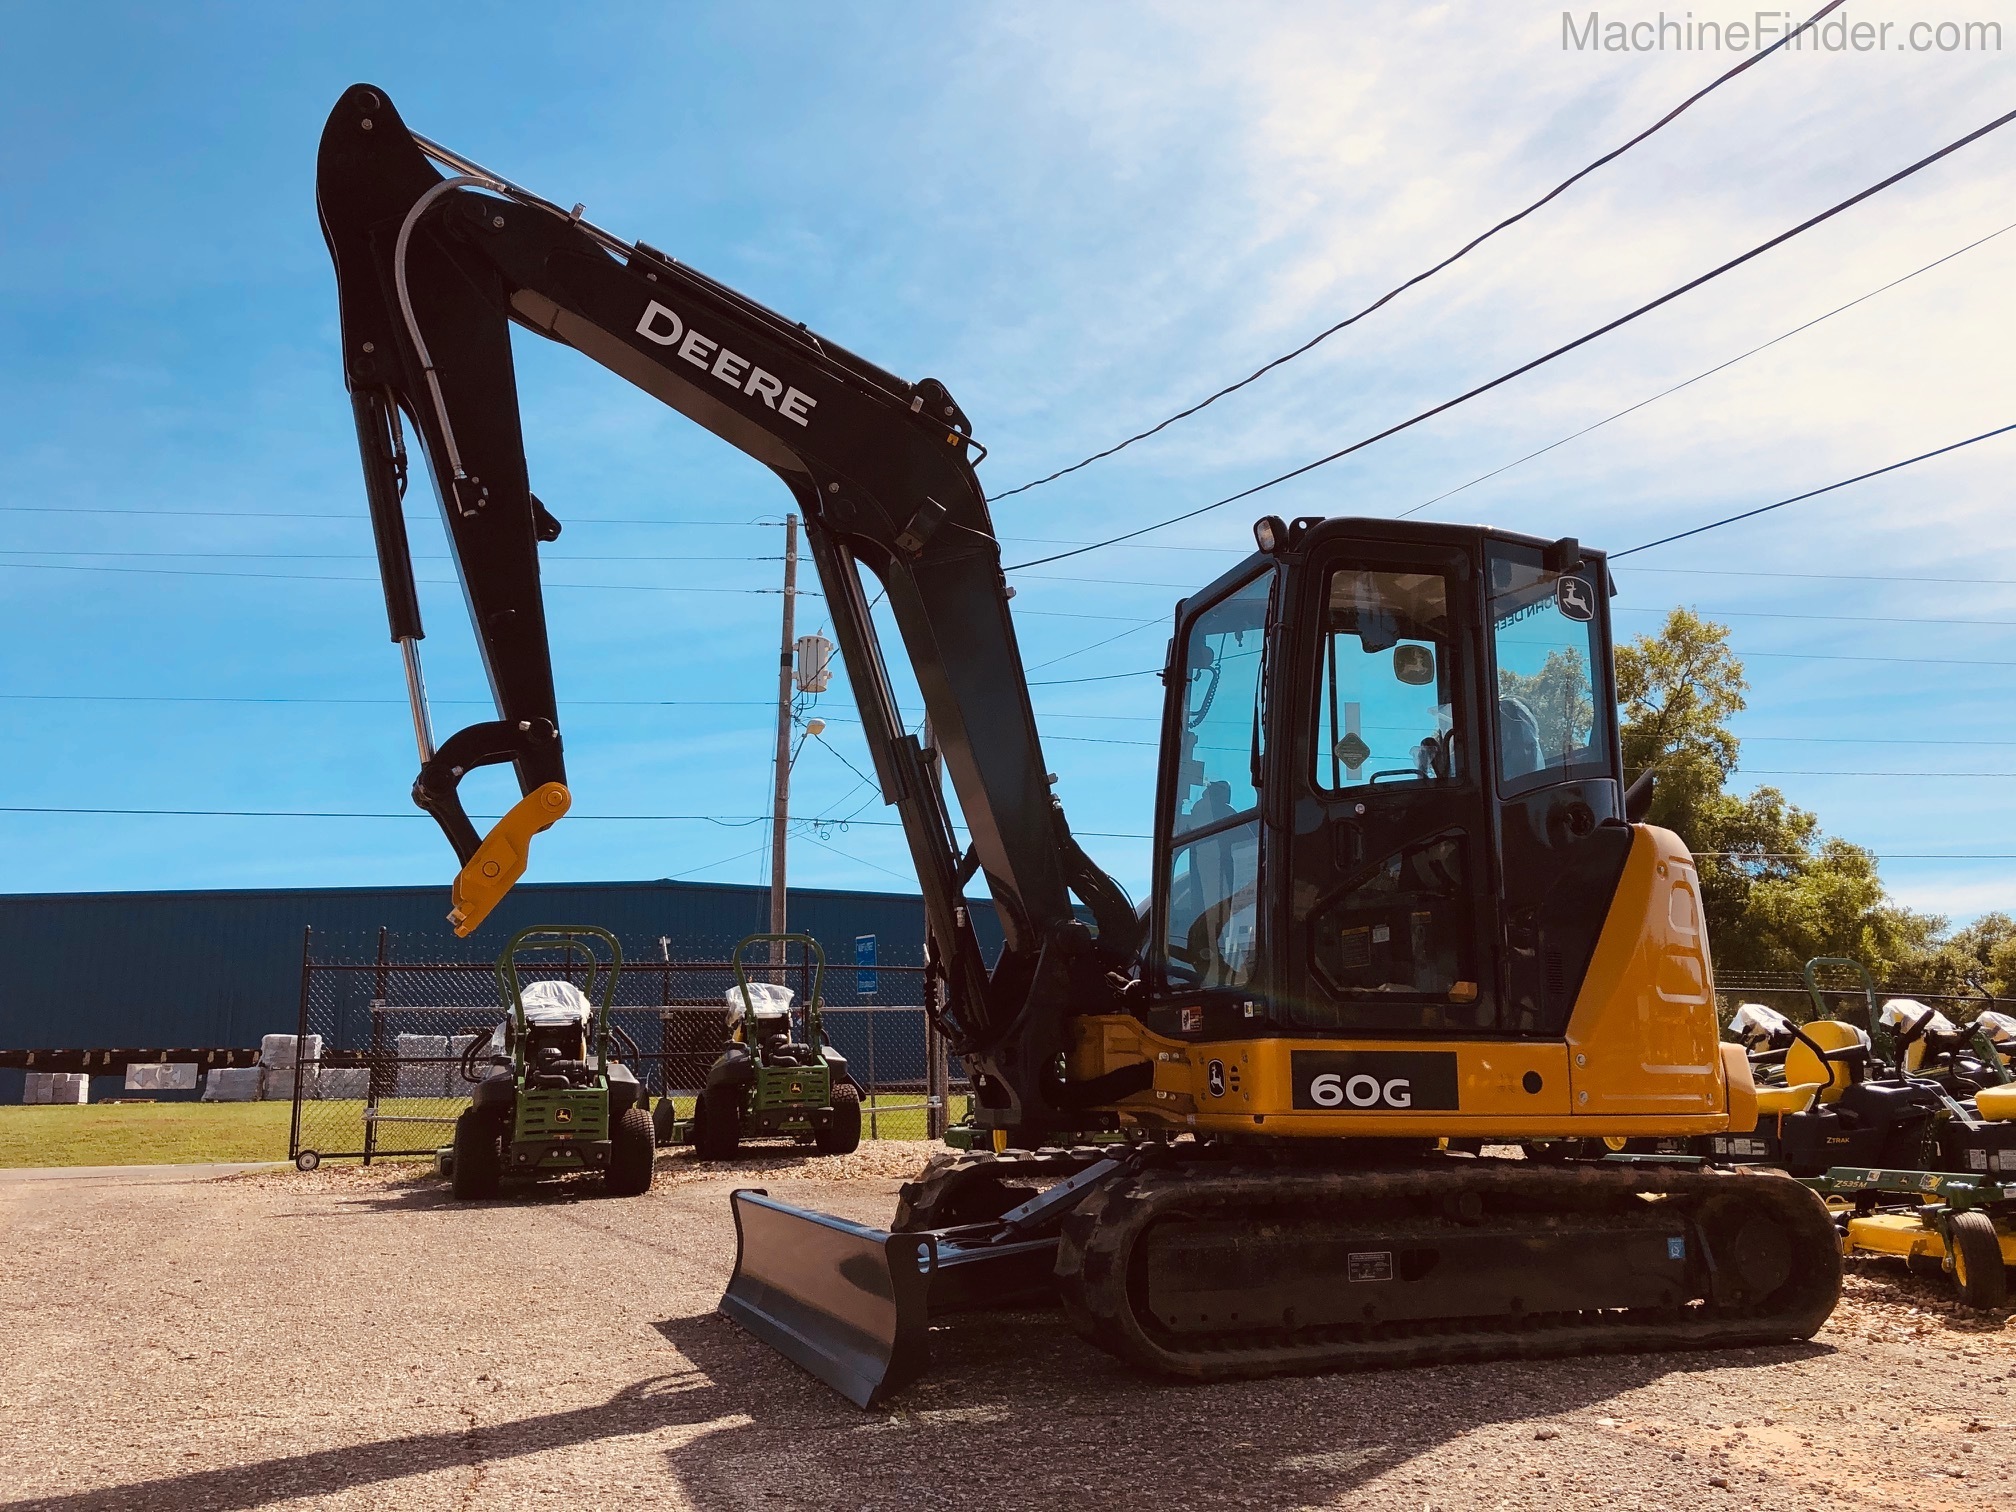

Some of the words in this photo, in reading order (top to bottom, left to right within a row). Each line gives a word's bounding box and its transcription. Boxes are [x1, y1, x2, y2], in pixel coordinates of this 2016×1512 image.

[635, 299, 818, 428] DEERE
[1310, 1073, 1412, 1108] 60G
[1826, 1136, 1850, 1144] ZTRAK
